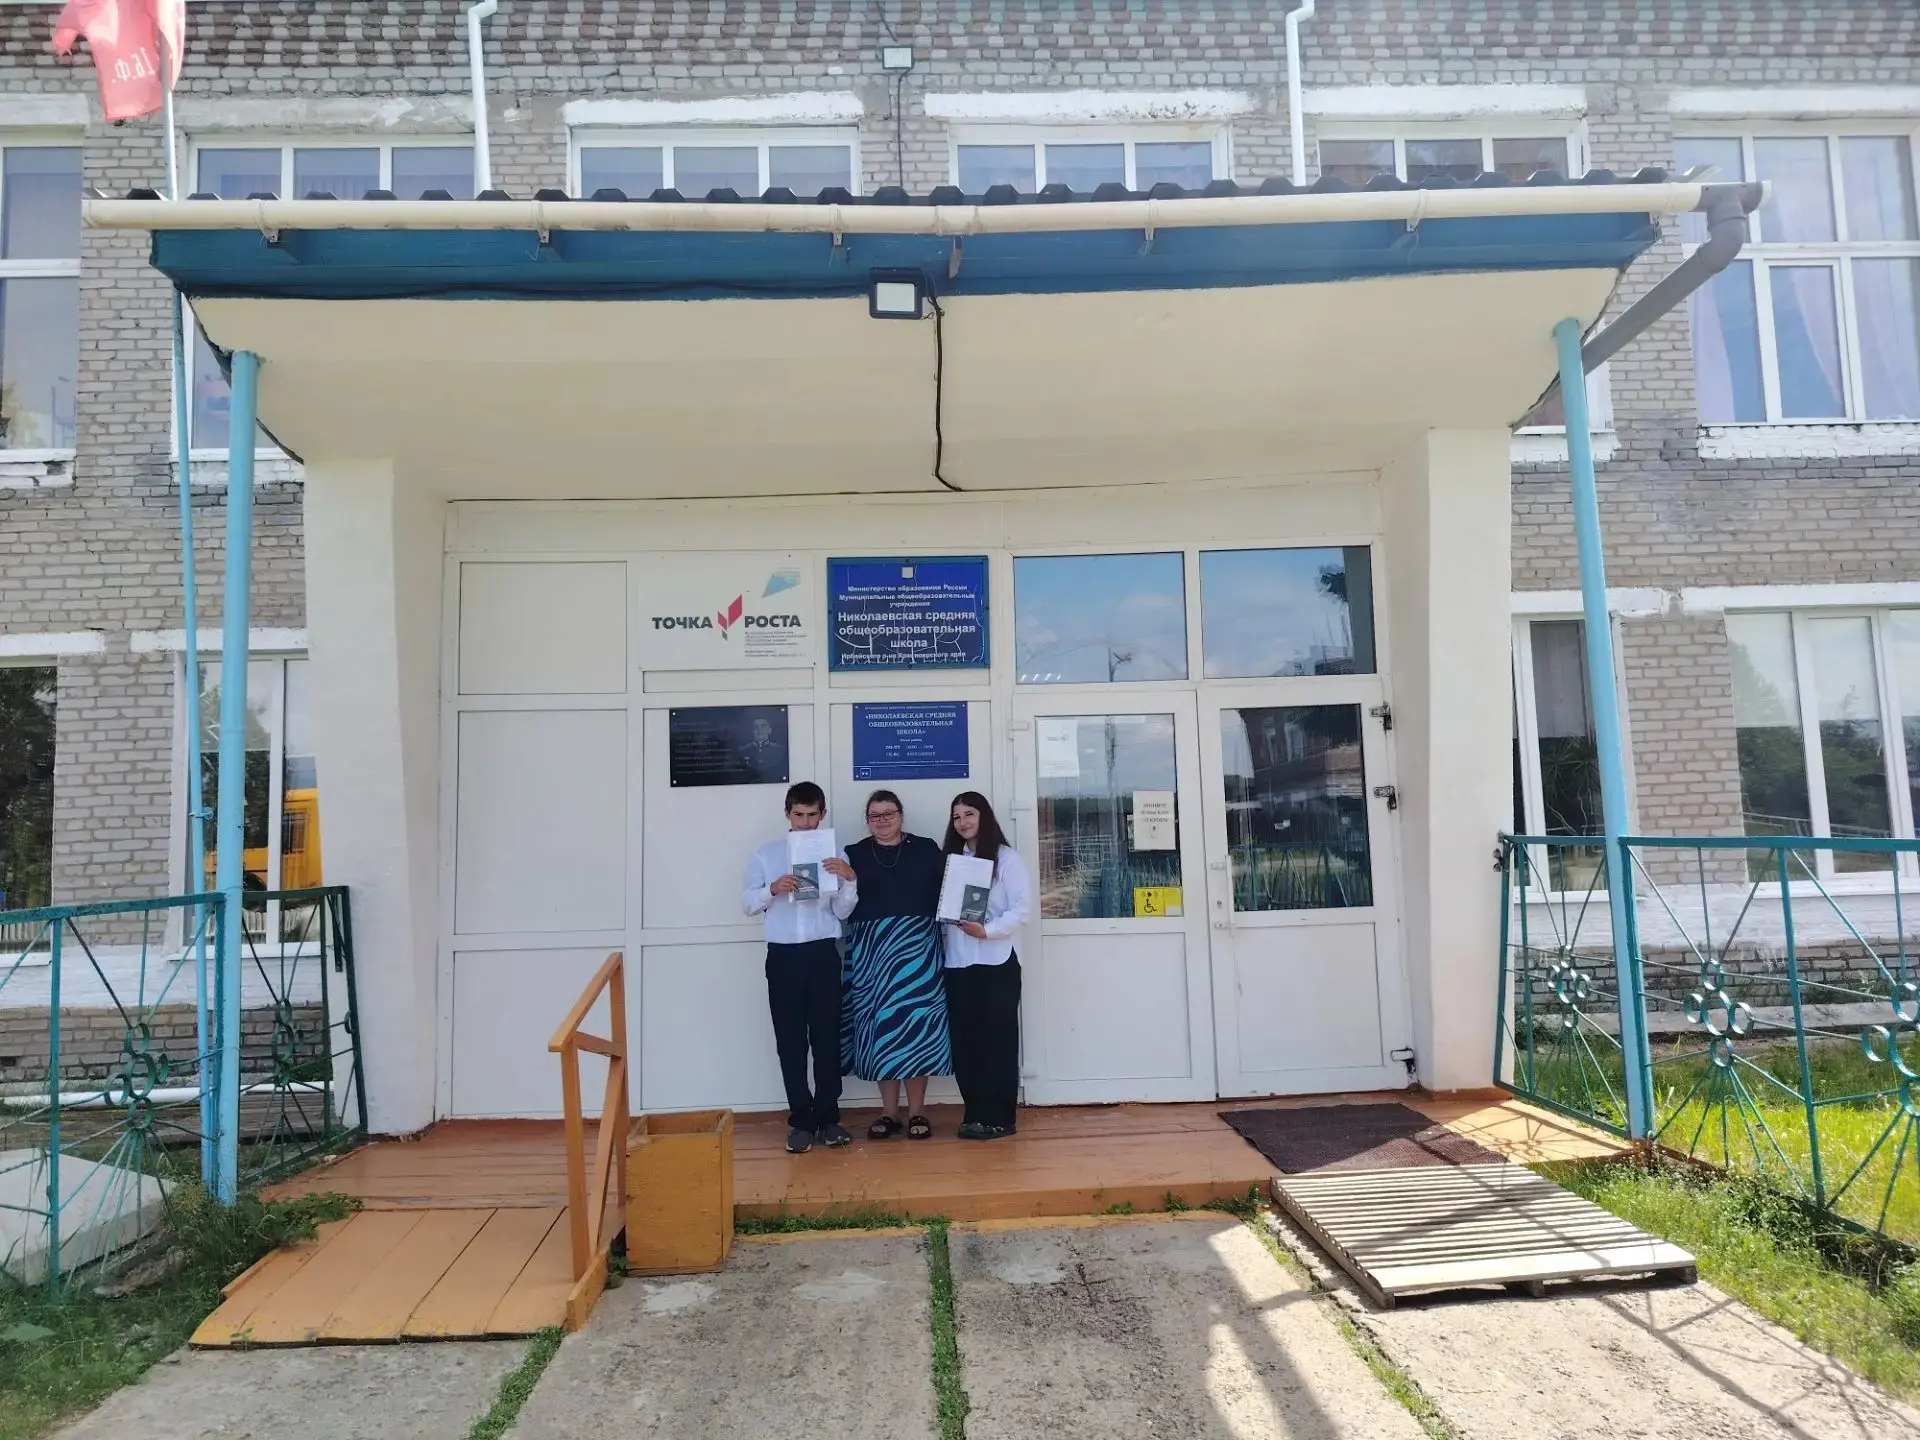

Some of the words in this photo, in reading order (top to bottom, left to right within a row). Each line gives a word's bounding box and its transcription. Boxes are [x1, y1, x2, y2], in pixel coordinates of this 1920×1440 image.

[943, 583, 968, 591] России
[744, 615, 802, 628] РОСТА
[837, 611, 922, 622] Николаевская
[925, 611, 975, 622] средняя
[651, 616, 714, 630] ТОЧКА
[838, 624, 976, 636] общеобразовательная
[890, 639, 928, 649] школа
[924, 711, 957, 719] СРЕДНЯЯ
[868, 720, 954, 728] ОБЩЕОБРАЗОВАТЕЛЬНАЯ
